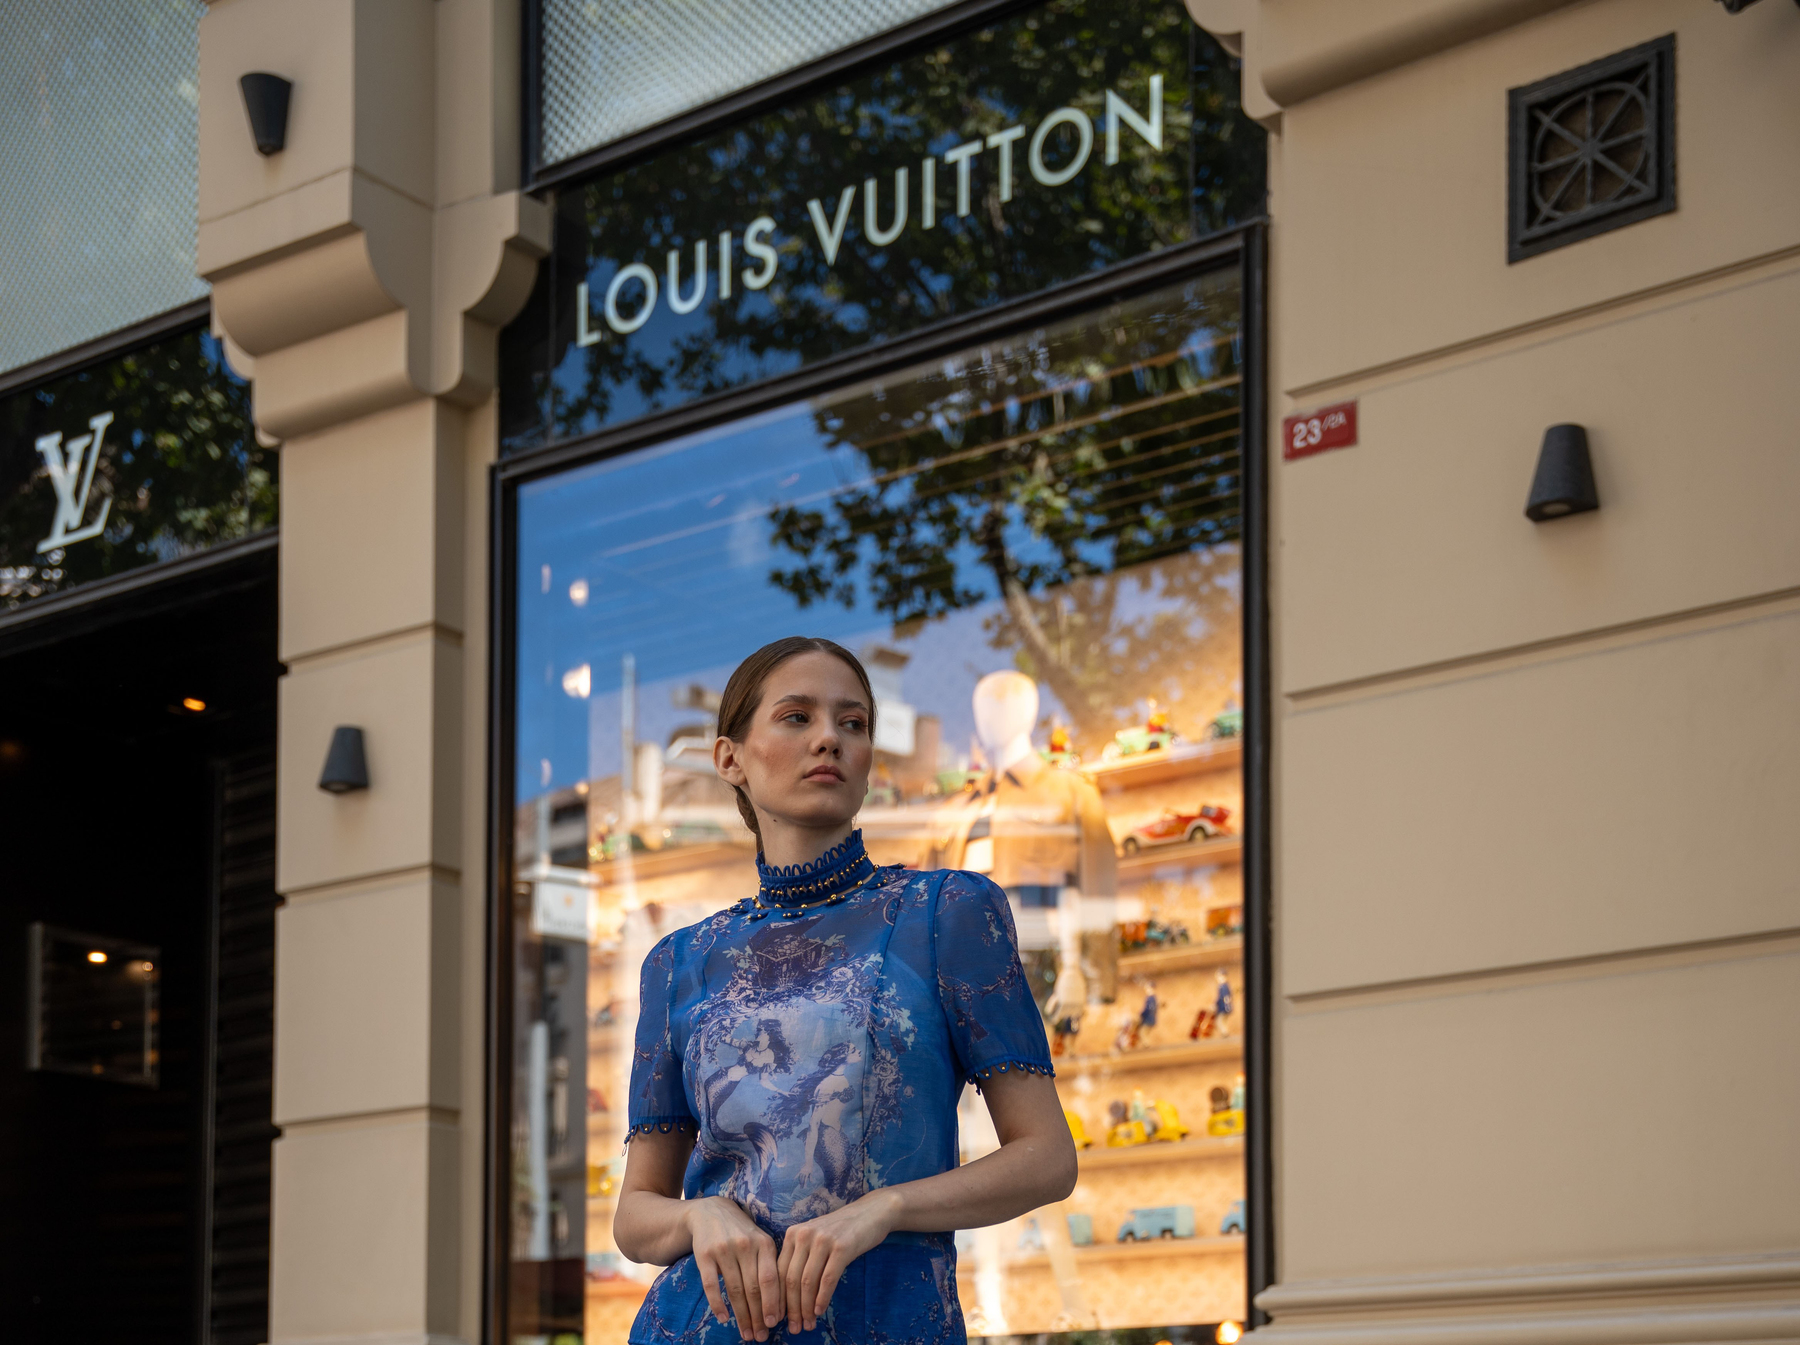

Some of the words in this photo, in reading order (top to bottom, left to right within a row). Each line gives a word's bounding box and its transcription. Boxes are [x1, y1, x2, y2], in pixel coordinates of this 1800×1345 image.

[576, 216, 779, 348] LOUIS
[806, 73, 1164, 267] VUITTON
[35, 410, 115, 554] LV
